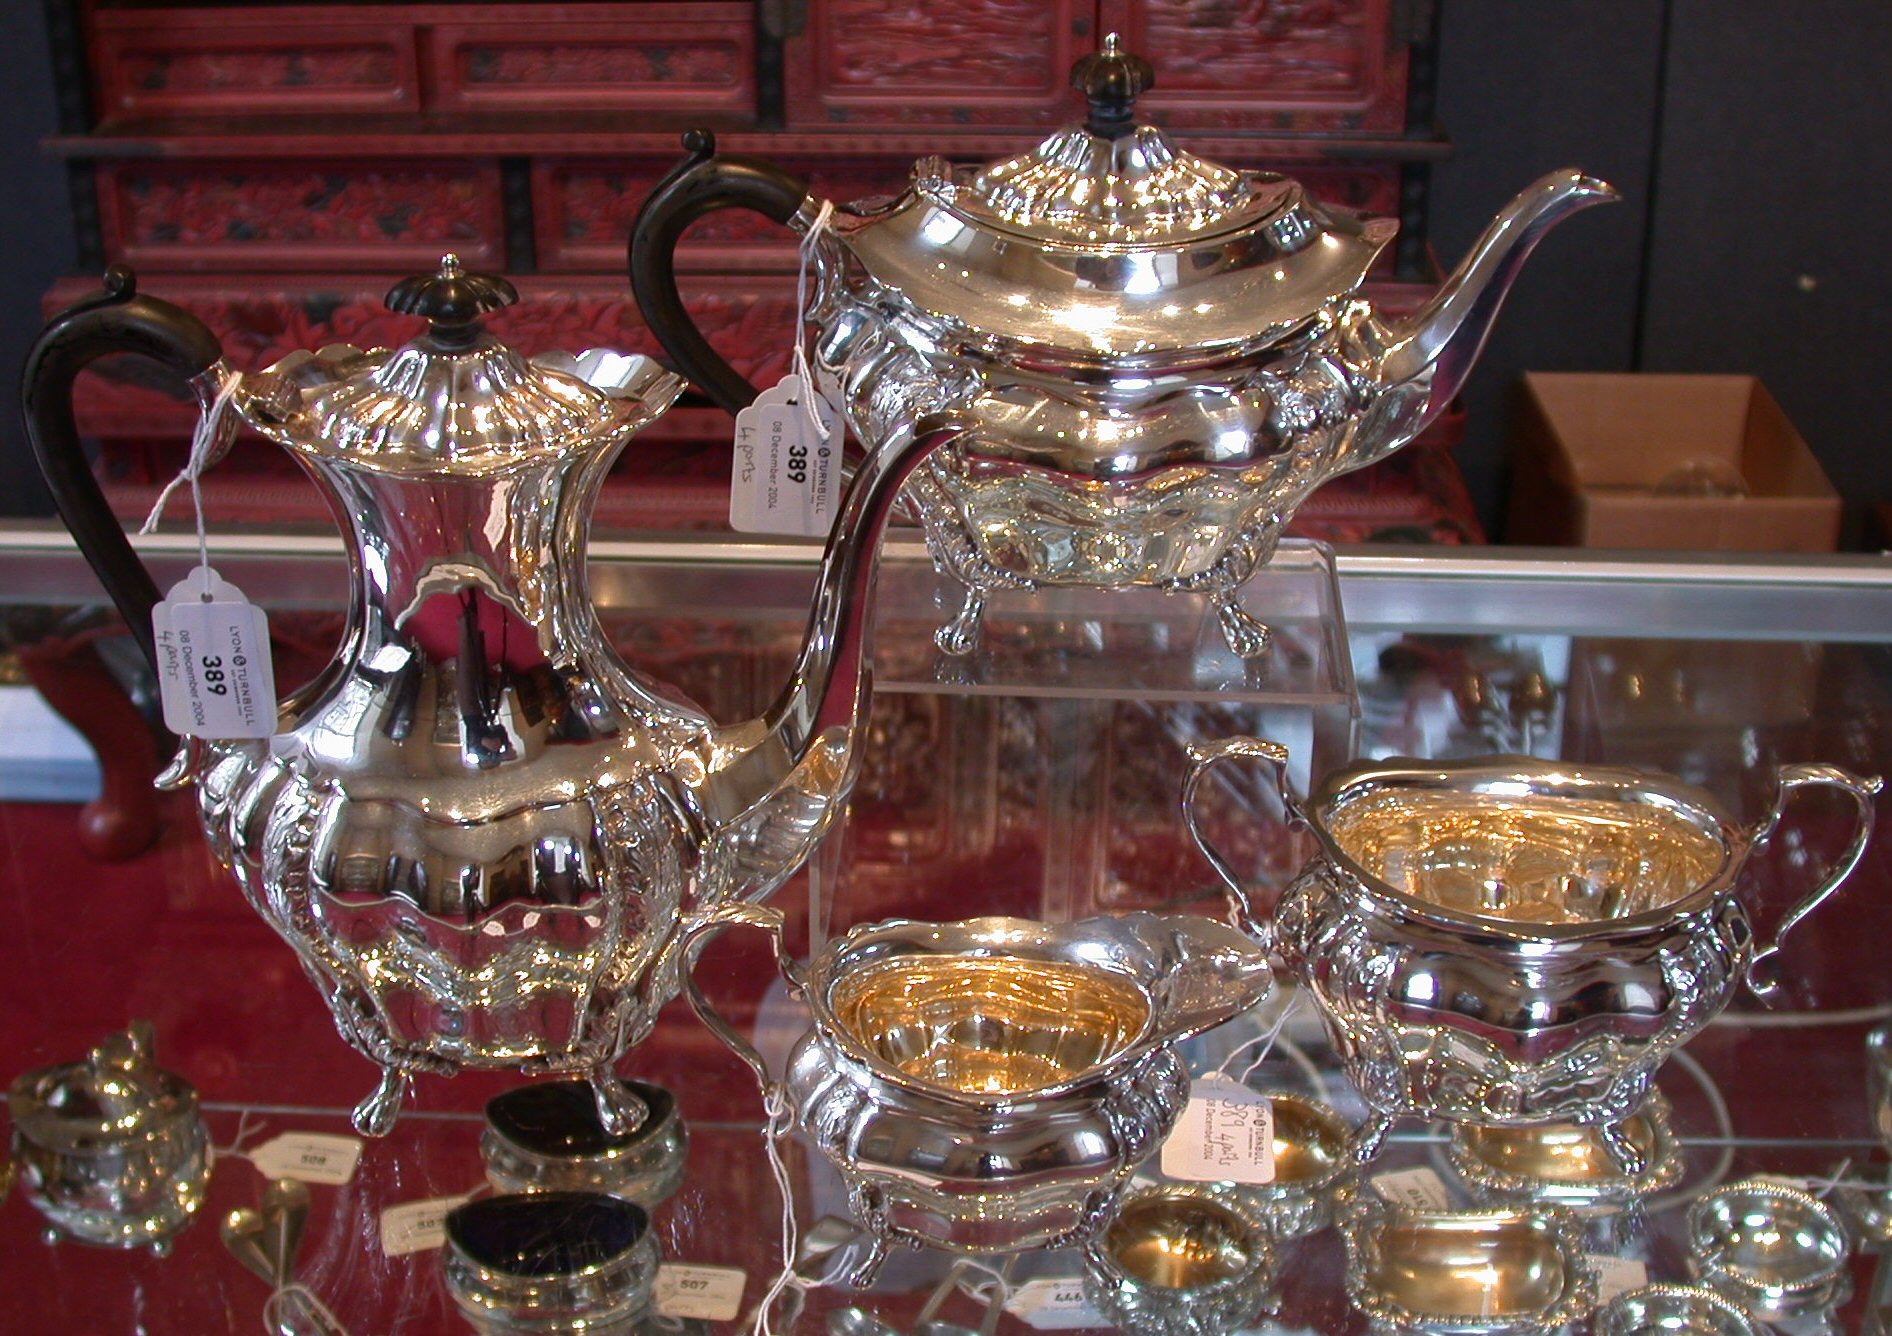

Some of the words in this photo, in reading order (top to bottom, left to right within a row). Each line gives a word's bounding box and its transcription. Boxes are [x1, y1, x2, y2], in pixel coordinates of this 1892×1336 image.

[738, 427, 756, 441] 4
[772, 421, 782, 433] 08
[821, 419, 831, 446] LYN
[770, 435, 781, 486] December
[787, 445, 808, 484] 389
[768, 488, 778, 509] 2004
[816, 459, 829, 514] TURNBULL
[179, 630, 189, 643] 08
[182, 646, 198, 699] December
[202, 655, 227, 696] 389
[229, 626, 242, 656] LYON
[237, 668, 255, 726] TURNBULL
[192, 701, 205, 726] 2004
[1205, 1108, 1216, 1144] December
[1220, 1098, 1248, 1127] 389
[680, 1280, 708, 1289] 507
